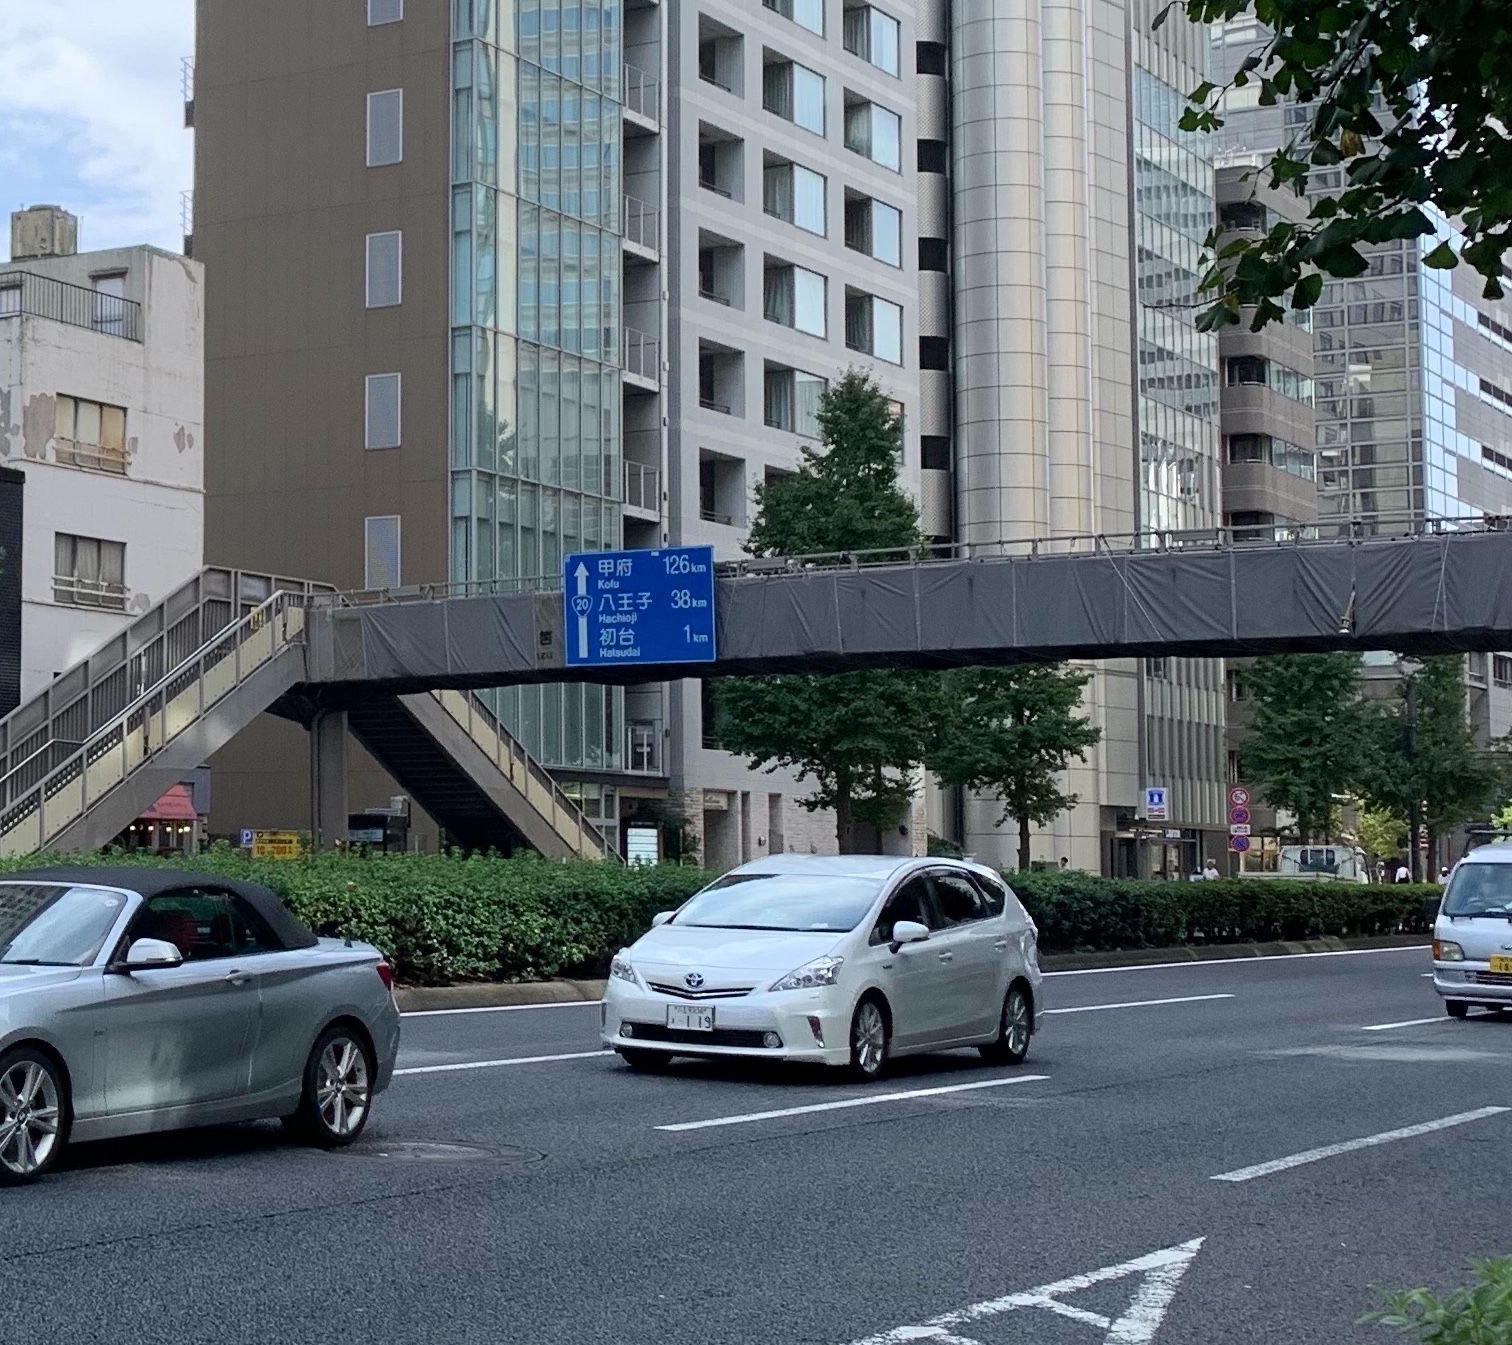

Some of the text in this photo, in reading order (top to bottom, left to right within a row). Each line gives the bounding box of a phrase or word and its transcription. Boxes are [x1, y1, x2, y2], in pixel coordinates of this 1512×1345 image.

[598, 559, 633, 576] 甲府
[598, 579, 620, 589] Kofu
[576, 598, 589, 610] 20
[599, 592, 653, 611] 八王子
[599, 612, 638, 624] Hachioji
[599, 627, 635, 646] 初台
[599, 647, 641, 657] Hatsudai
[243, 829, 252, 844] P
